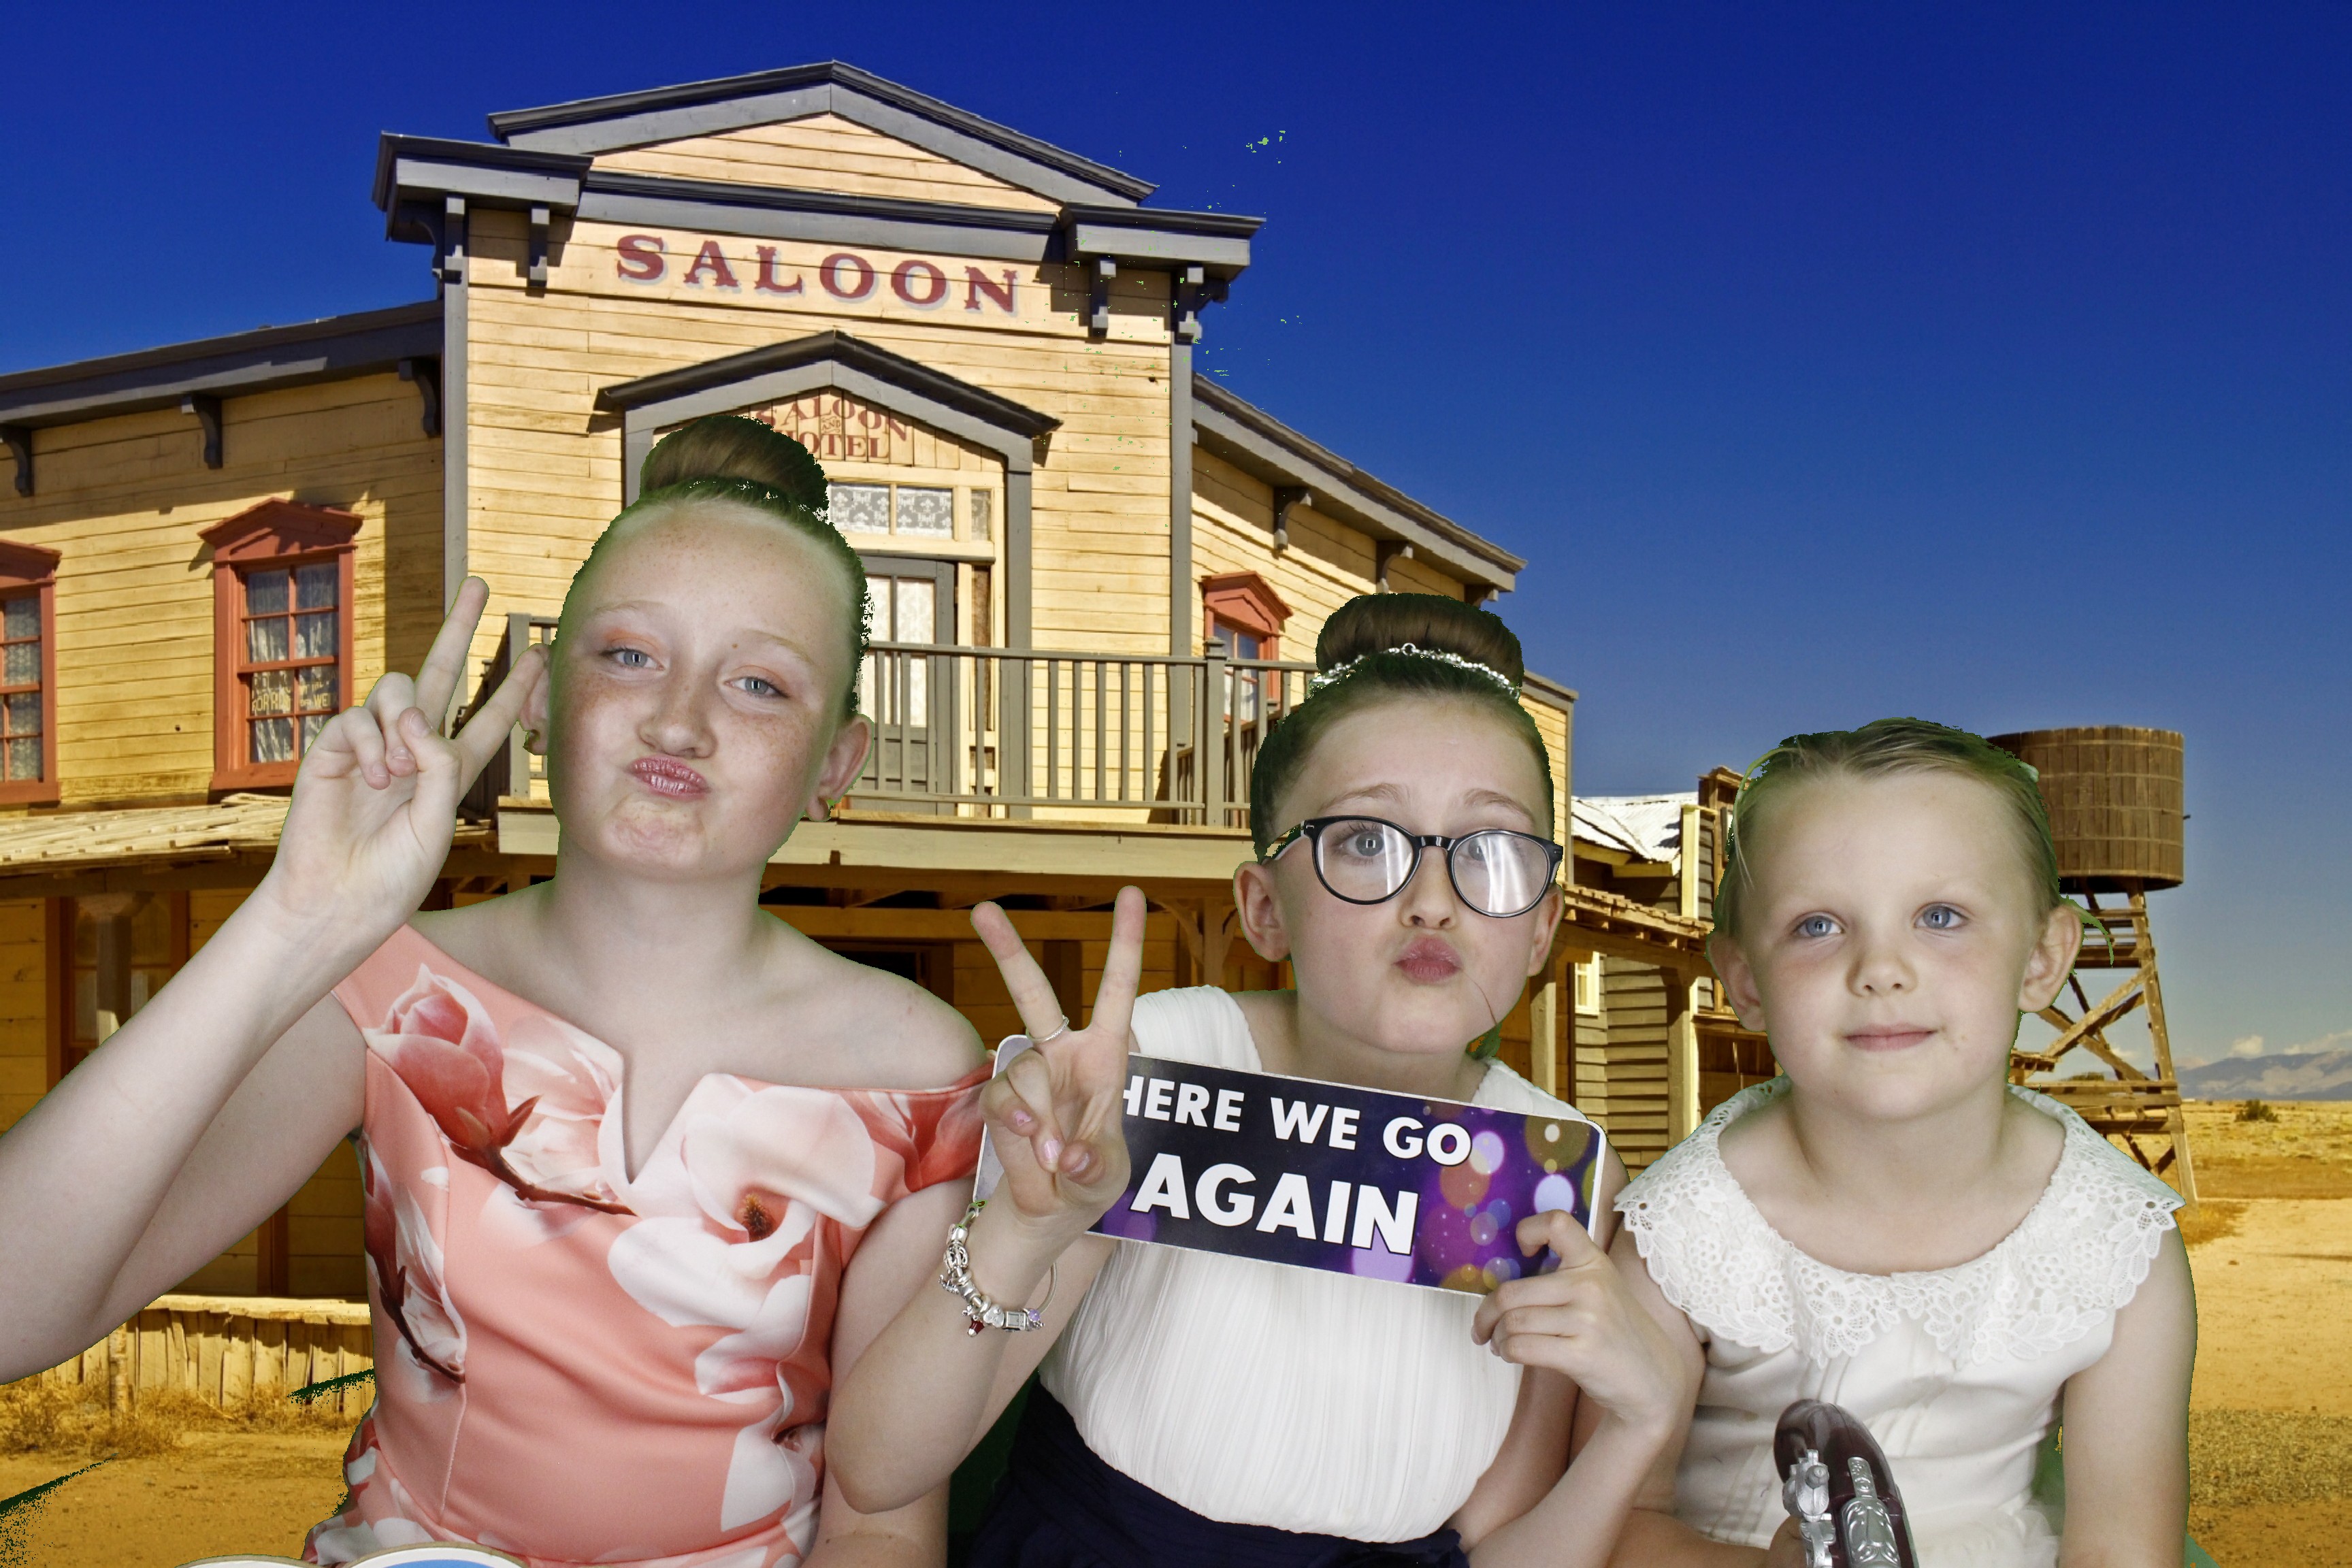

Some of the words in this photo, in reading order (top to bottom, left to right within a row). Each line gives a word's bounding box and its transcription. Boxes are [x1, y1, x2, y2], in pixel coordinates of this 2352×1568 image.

[617, 234, 1017, 313] SALOON
[821, 419, 841, 430] AND
[1271, 1097, 1360, 1150] WE
[1382, 1117, 1471, 1166] GO
[1130, 1153, 1419, 1255] AGAIN
